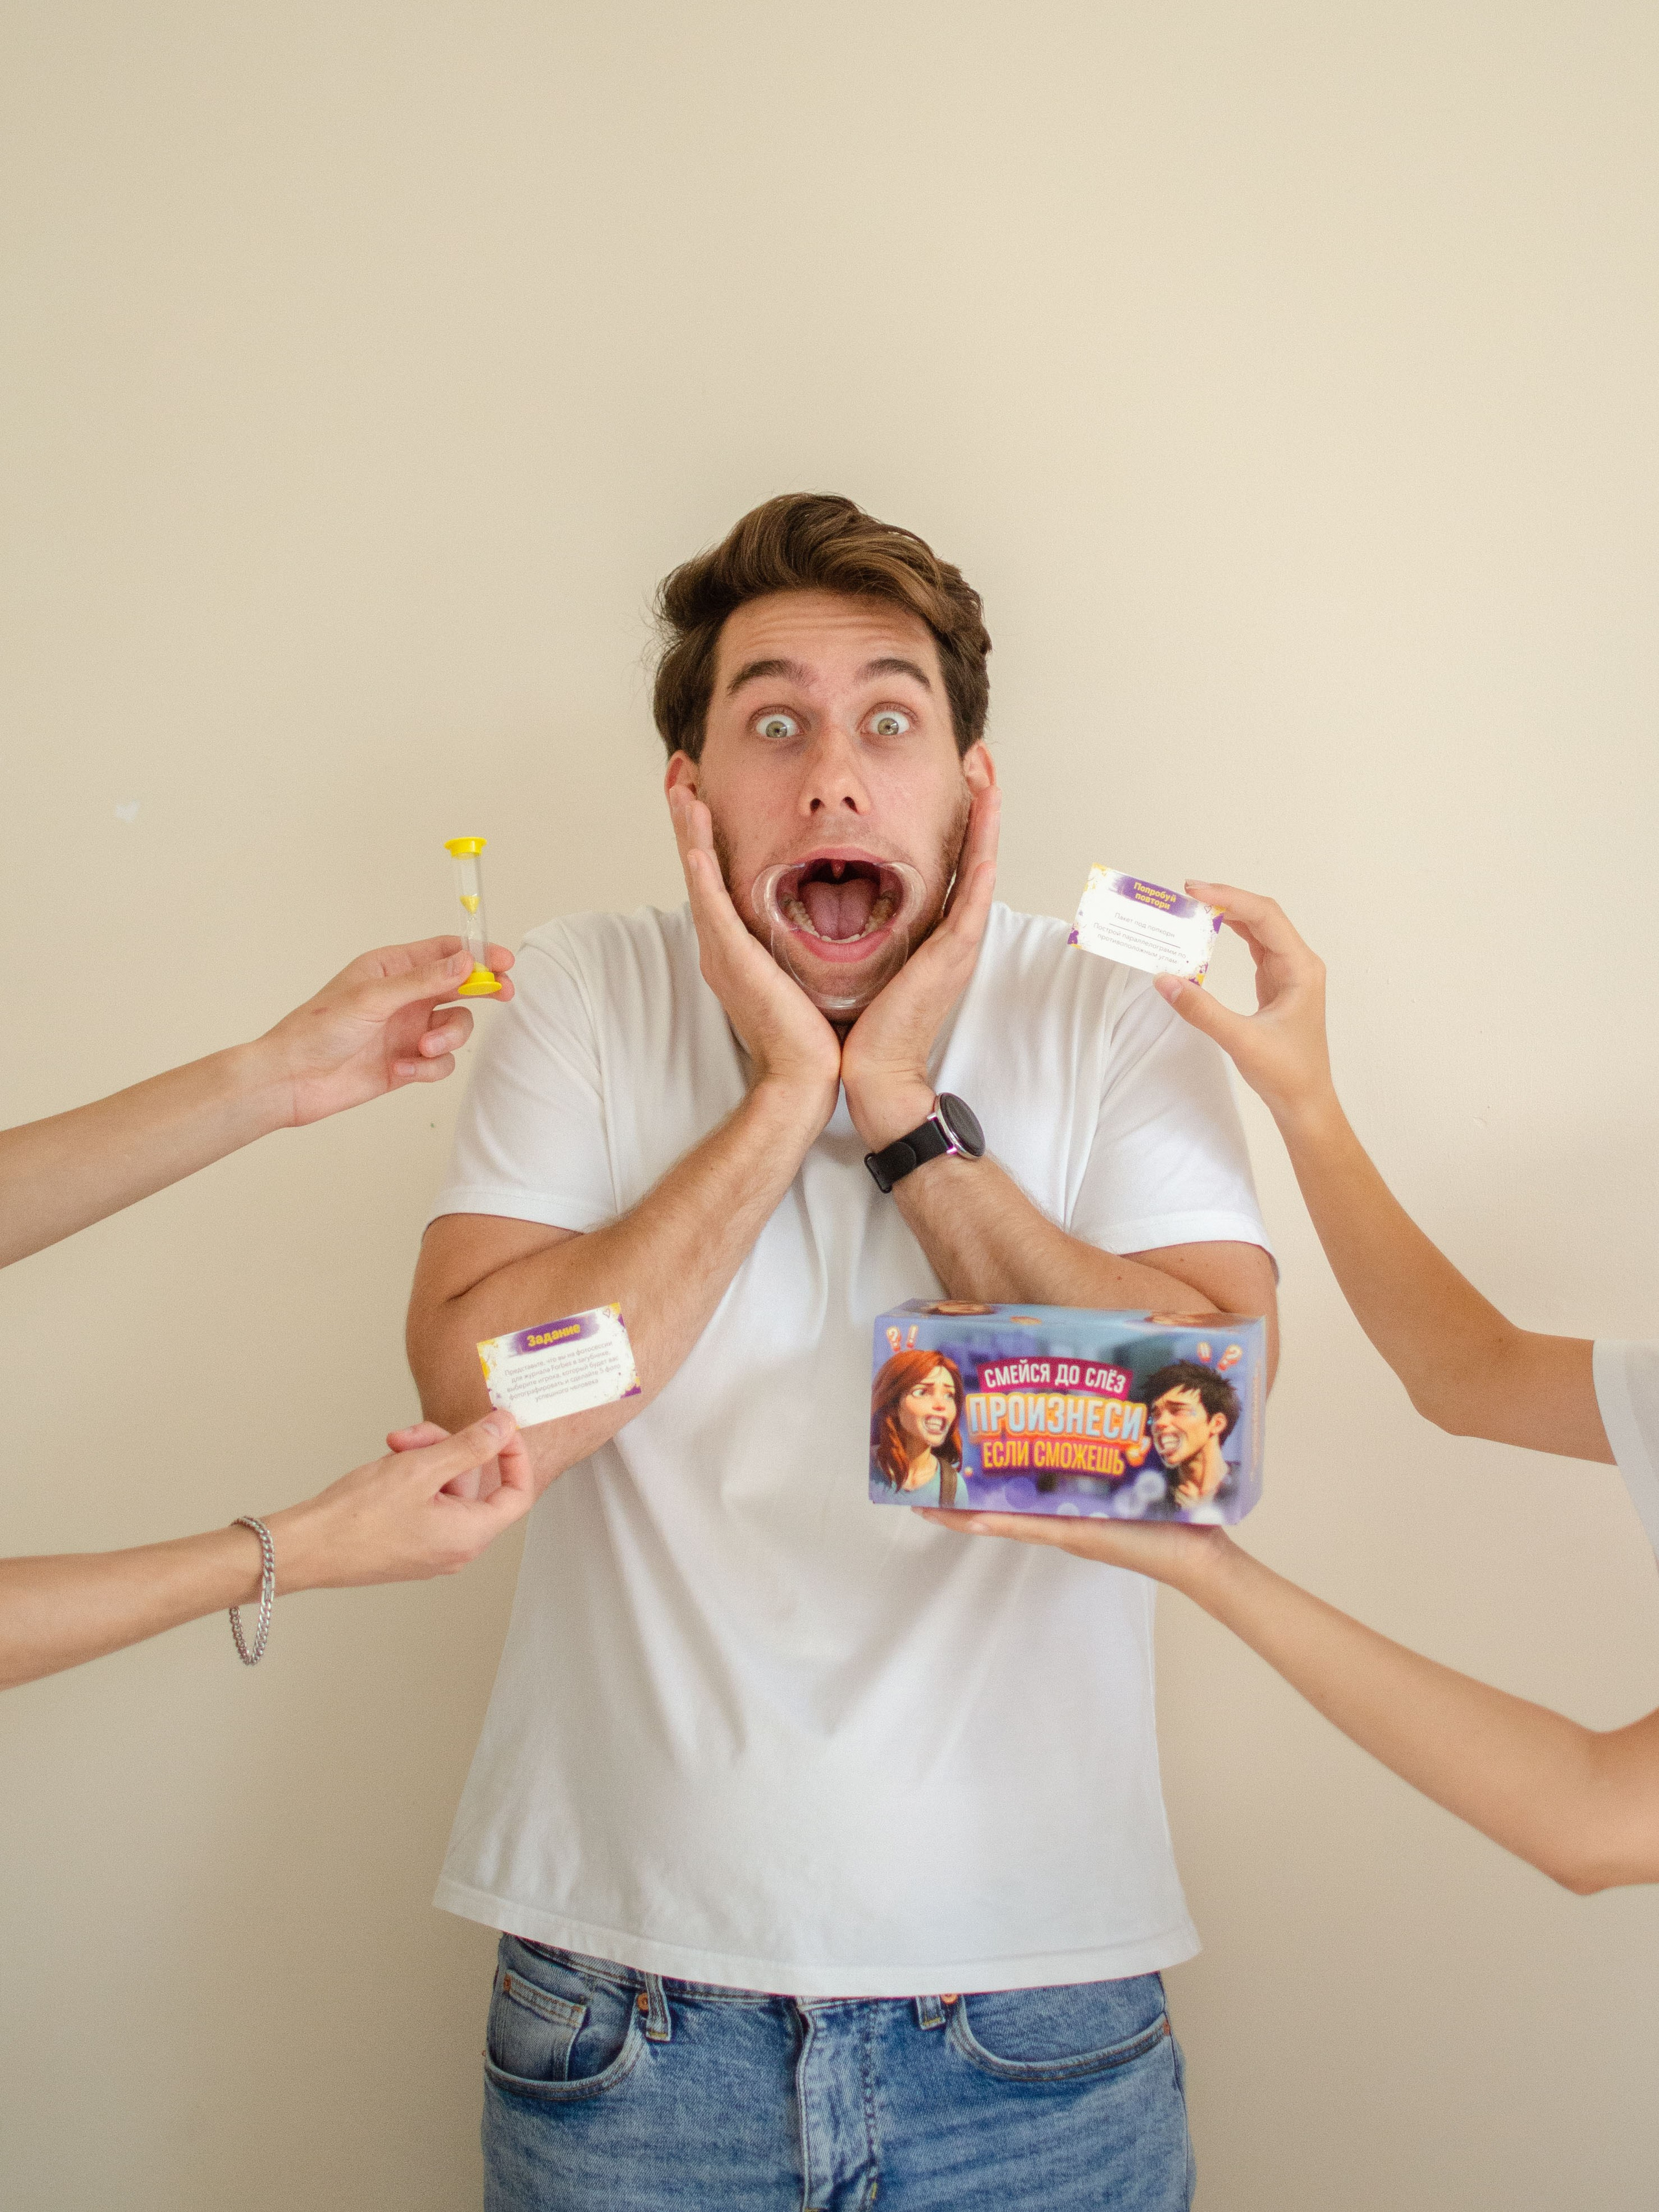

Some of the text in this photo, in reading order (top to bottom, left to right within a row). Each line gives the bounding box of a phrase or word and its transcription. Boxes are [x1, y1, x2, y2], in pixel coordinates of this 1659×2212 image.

[1133, 881, 1176, 903] Попробуй
[1135, 892, 1170, 910] повтори
[1115, 912, 1175, 938] Пакет под попкорн
[1093, 922, 1121, 936] Построй
[1122, 933, 1177, 955] параллелограмм
[1097, 934, 1177, 964] противоположным углам
[527, 1323, 581, 1347] Задание
[551, 1360, 572, 1371] Forbes
[563, 1364, 588, 1376] который
[589, 1359, 607, 1369] будет
[984, 1358, 1126, 1394] СМЕЙСЯ ДО СЛЁЗ
[968, 1395, 1150, 1452] ПРОИЗНЕСИ,
[982, 1439, 1124, 1476] ЕСЛИ СМОЖЕШЬ
